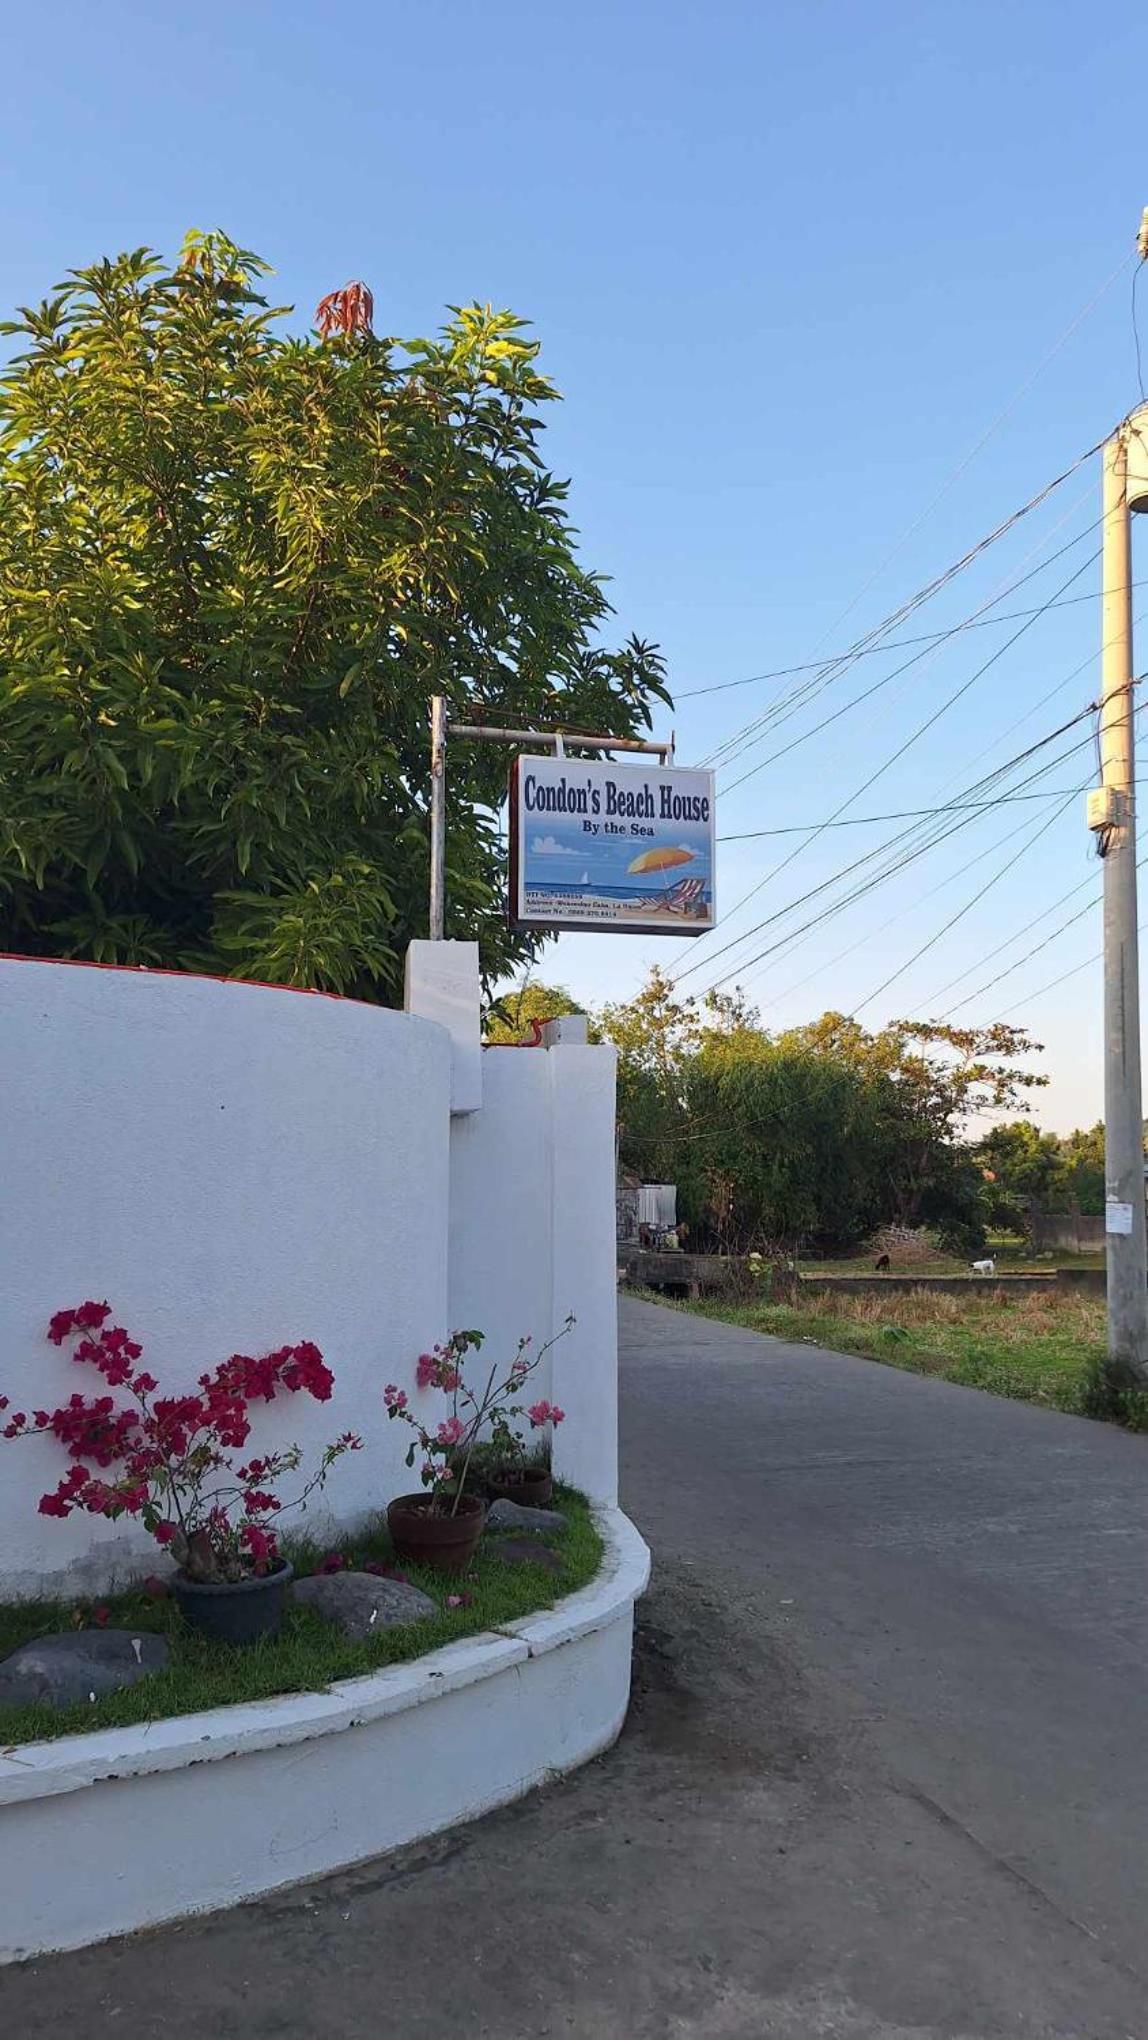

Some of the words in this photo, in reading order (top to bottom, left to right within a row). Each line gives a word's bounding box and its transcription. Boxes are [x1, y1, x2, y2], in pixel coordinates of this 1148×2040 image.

[524, 775, 600, 816] Condon's
[606, 781, 655, 818] Beach
[659, 785, 709, 823] House
[583, 820, 599, 835] By
[604, 822, 626, 835] the
[631, 824, 655, 836] Sea
